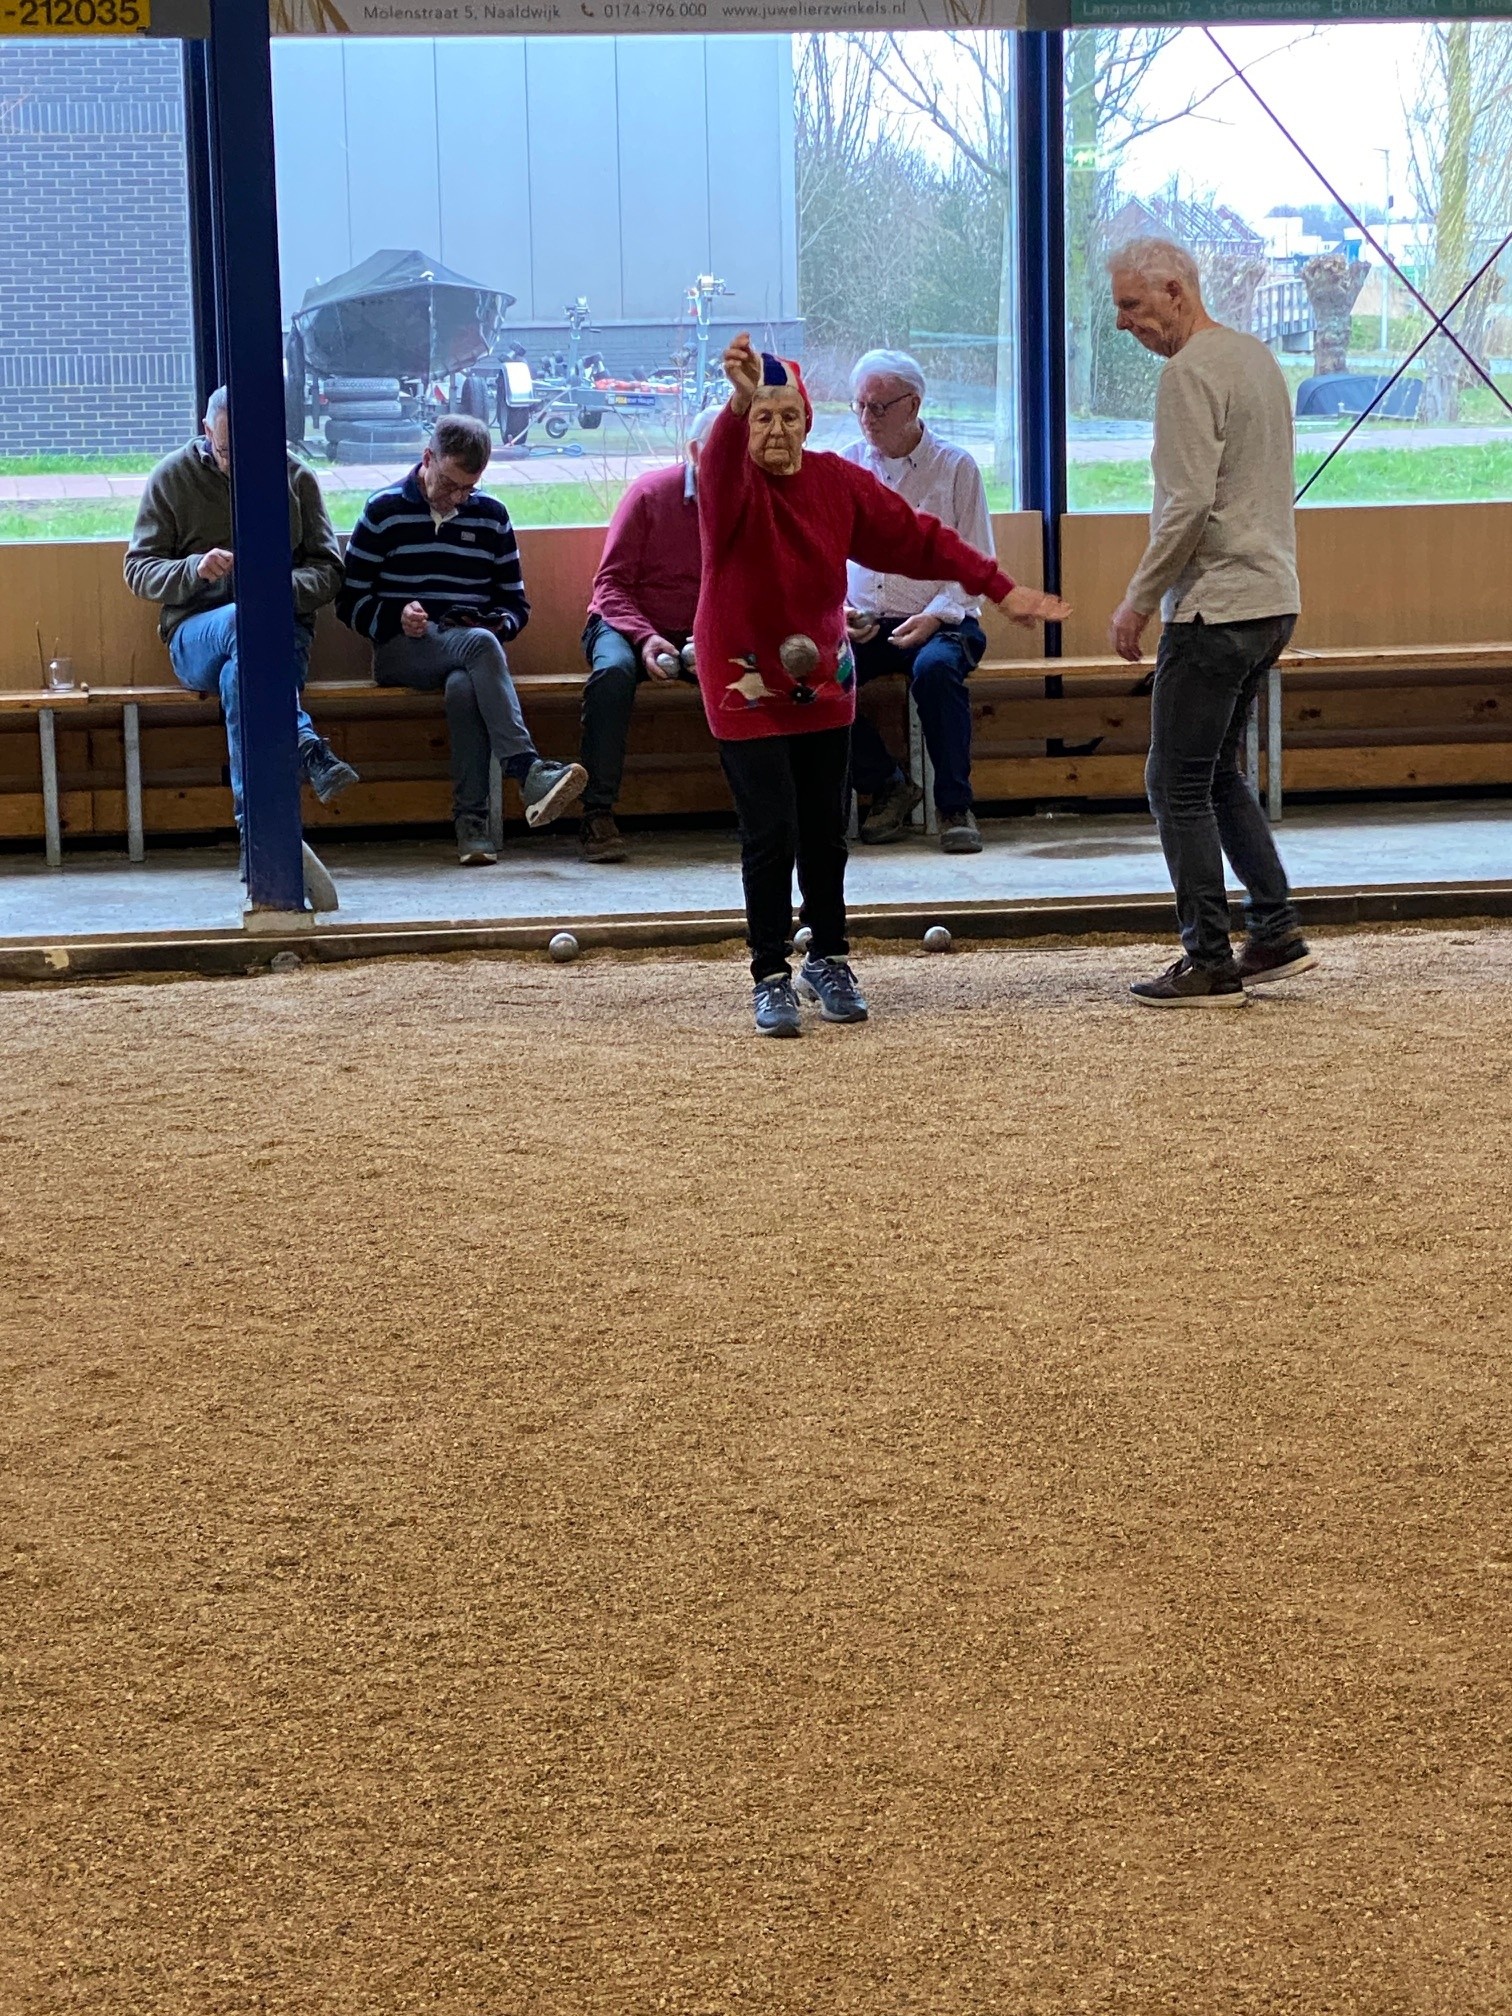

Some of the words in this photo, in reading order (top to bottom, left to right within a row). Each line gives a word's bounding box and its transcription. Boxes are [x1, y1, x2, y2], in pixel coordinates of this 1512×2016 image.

[363, 6, 459, 20] Molenstraat
[464, 6, 477, 21] 5,
[484, 5, 560, 22] Naaldwijk
[604, 4, 675, 18] 0174-796
[679, 3, 707, 17] 000
[722, 1, 906, 19] www.juwelierzwinkels.nl
[1083, 2, 1170, 17] Langestraat
